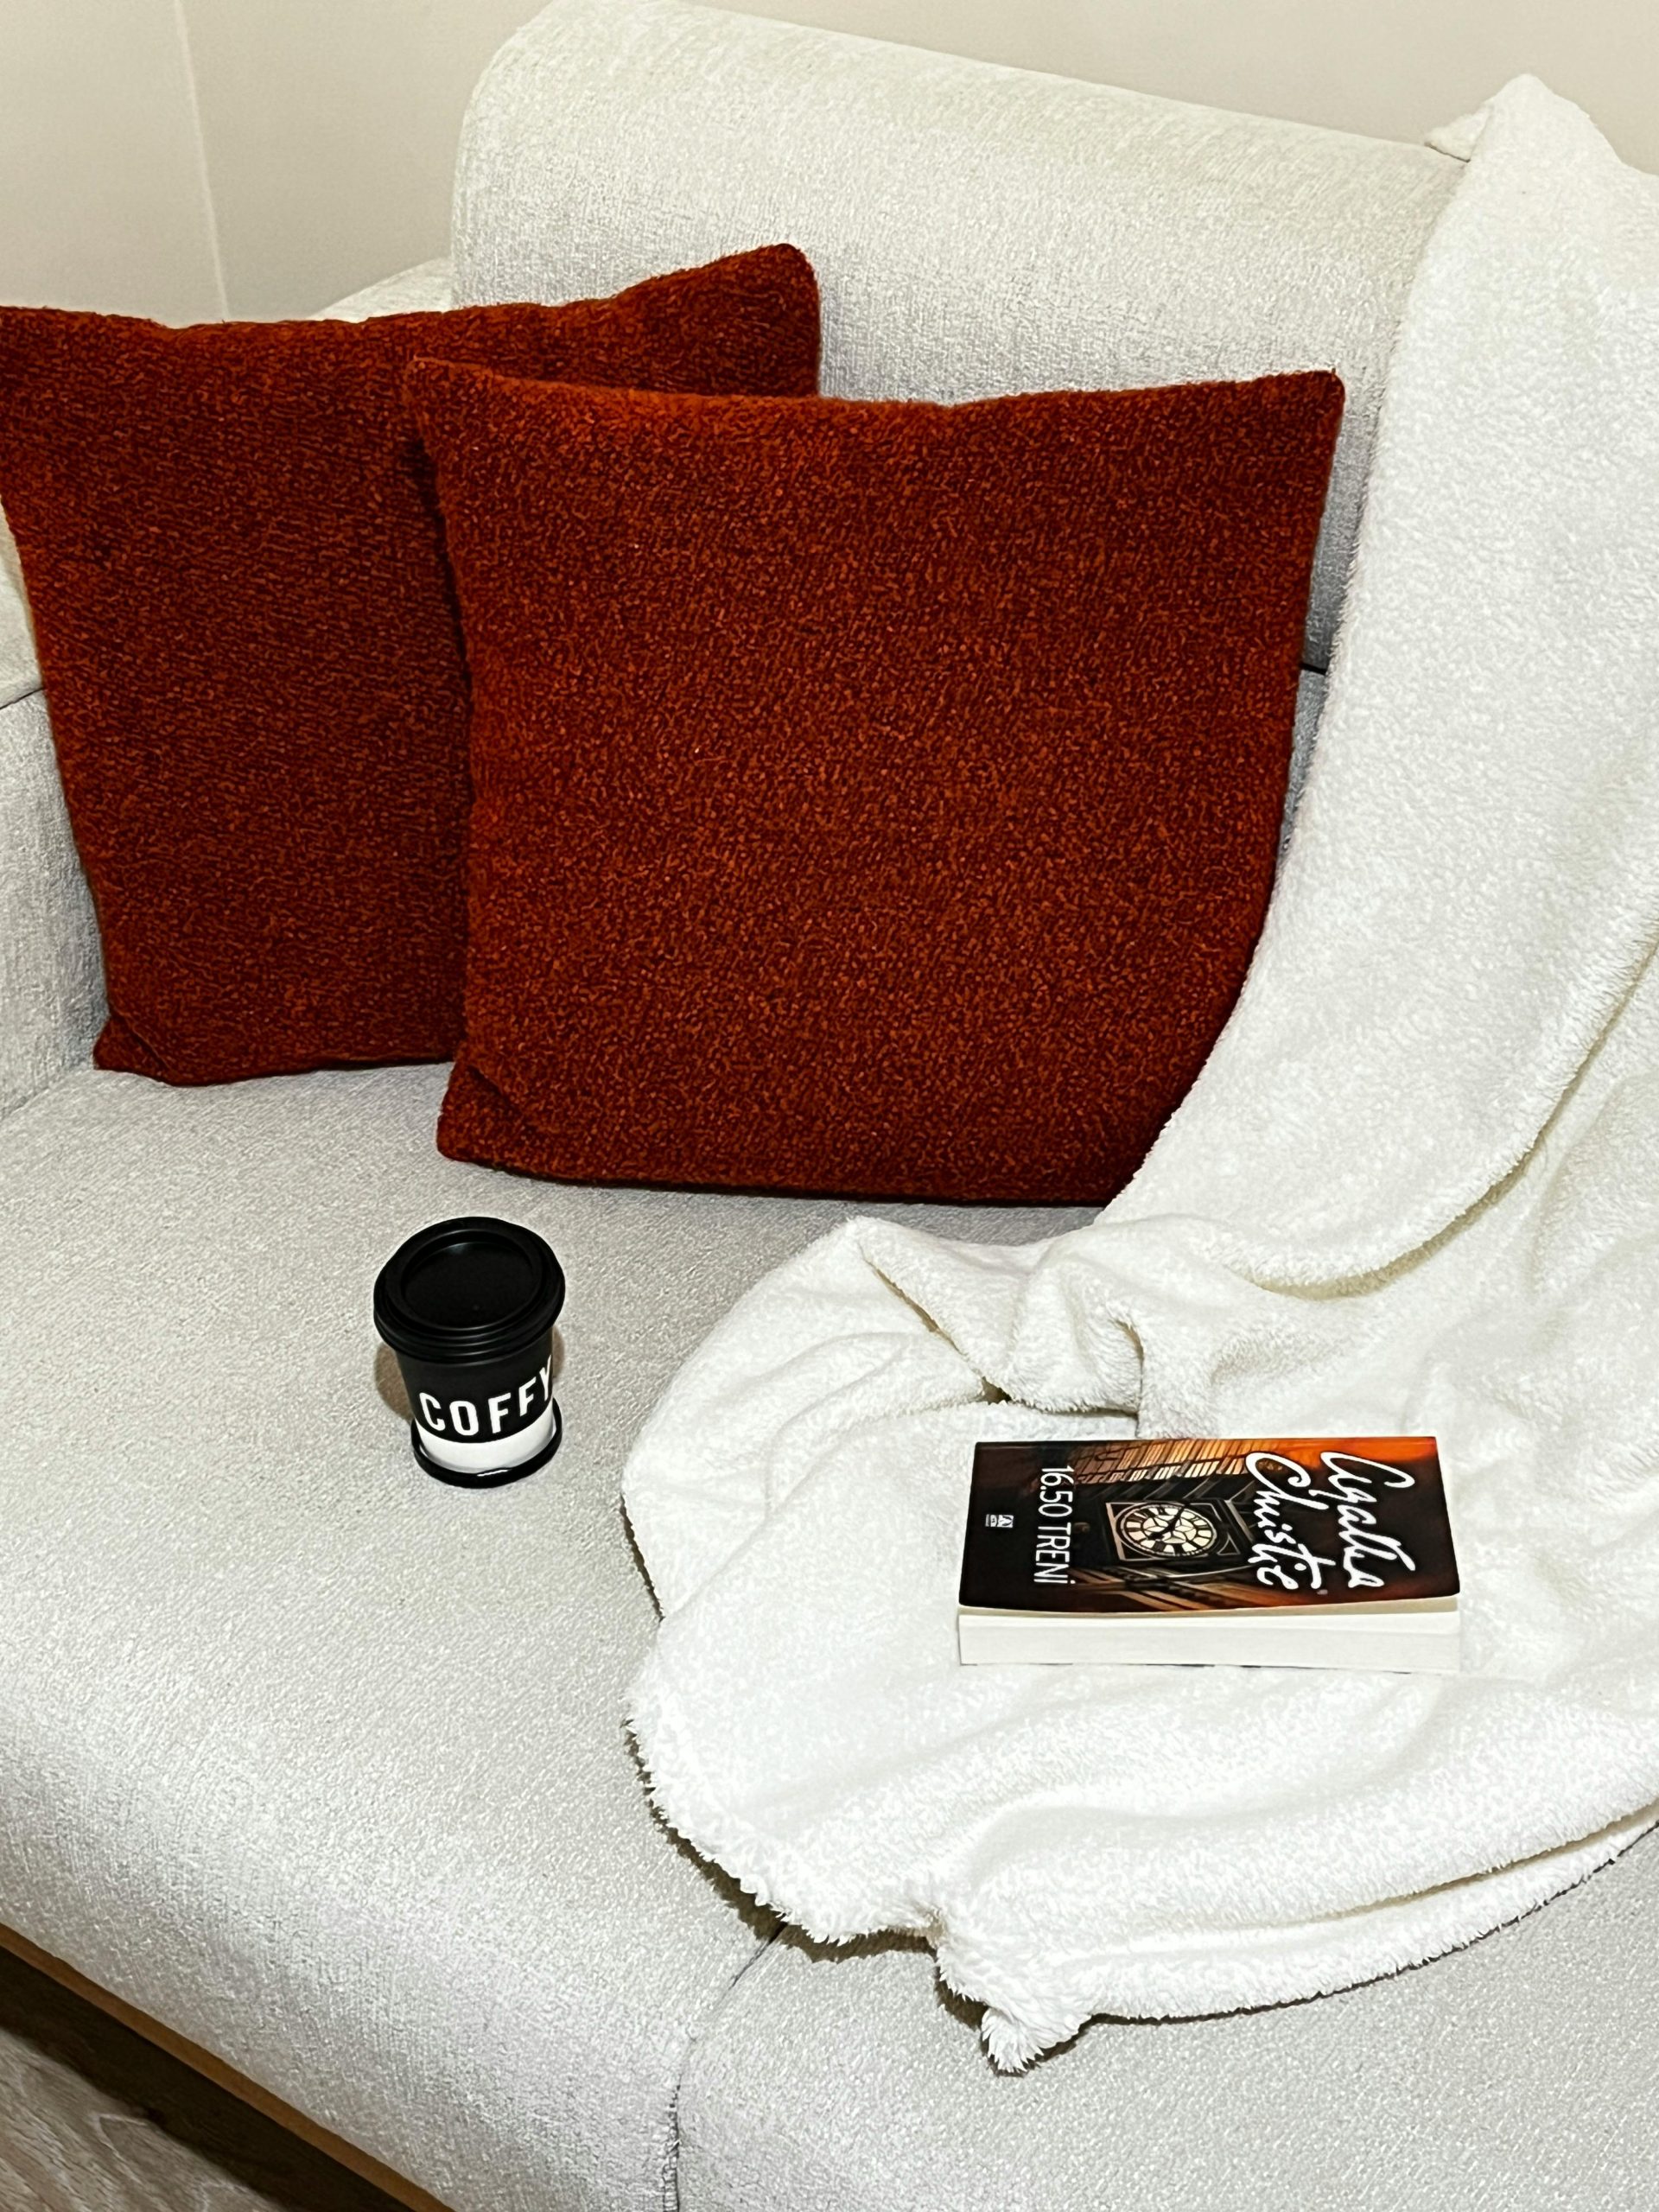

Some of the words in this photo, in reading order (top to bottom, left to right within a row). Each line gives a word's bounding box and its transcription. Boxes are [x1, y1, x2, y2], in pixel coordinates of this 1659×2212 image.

[419, 1354, 552, 1436] COFFY
[1038, 1465, 1075, 1517] 16.50
[1245, 1452, 1337, 1590] Christie
[1320, 1452, 1416, 1588] Agatha
